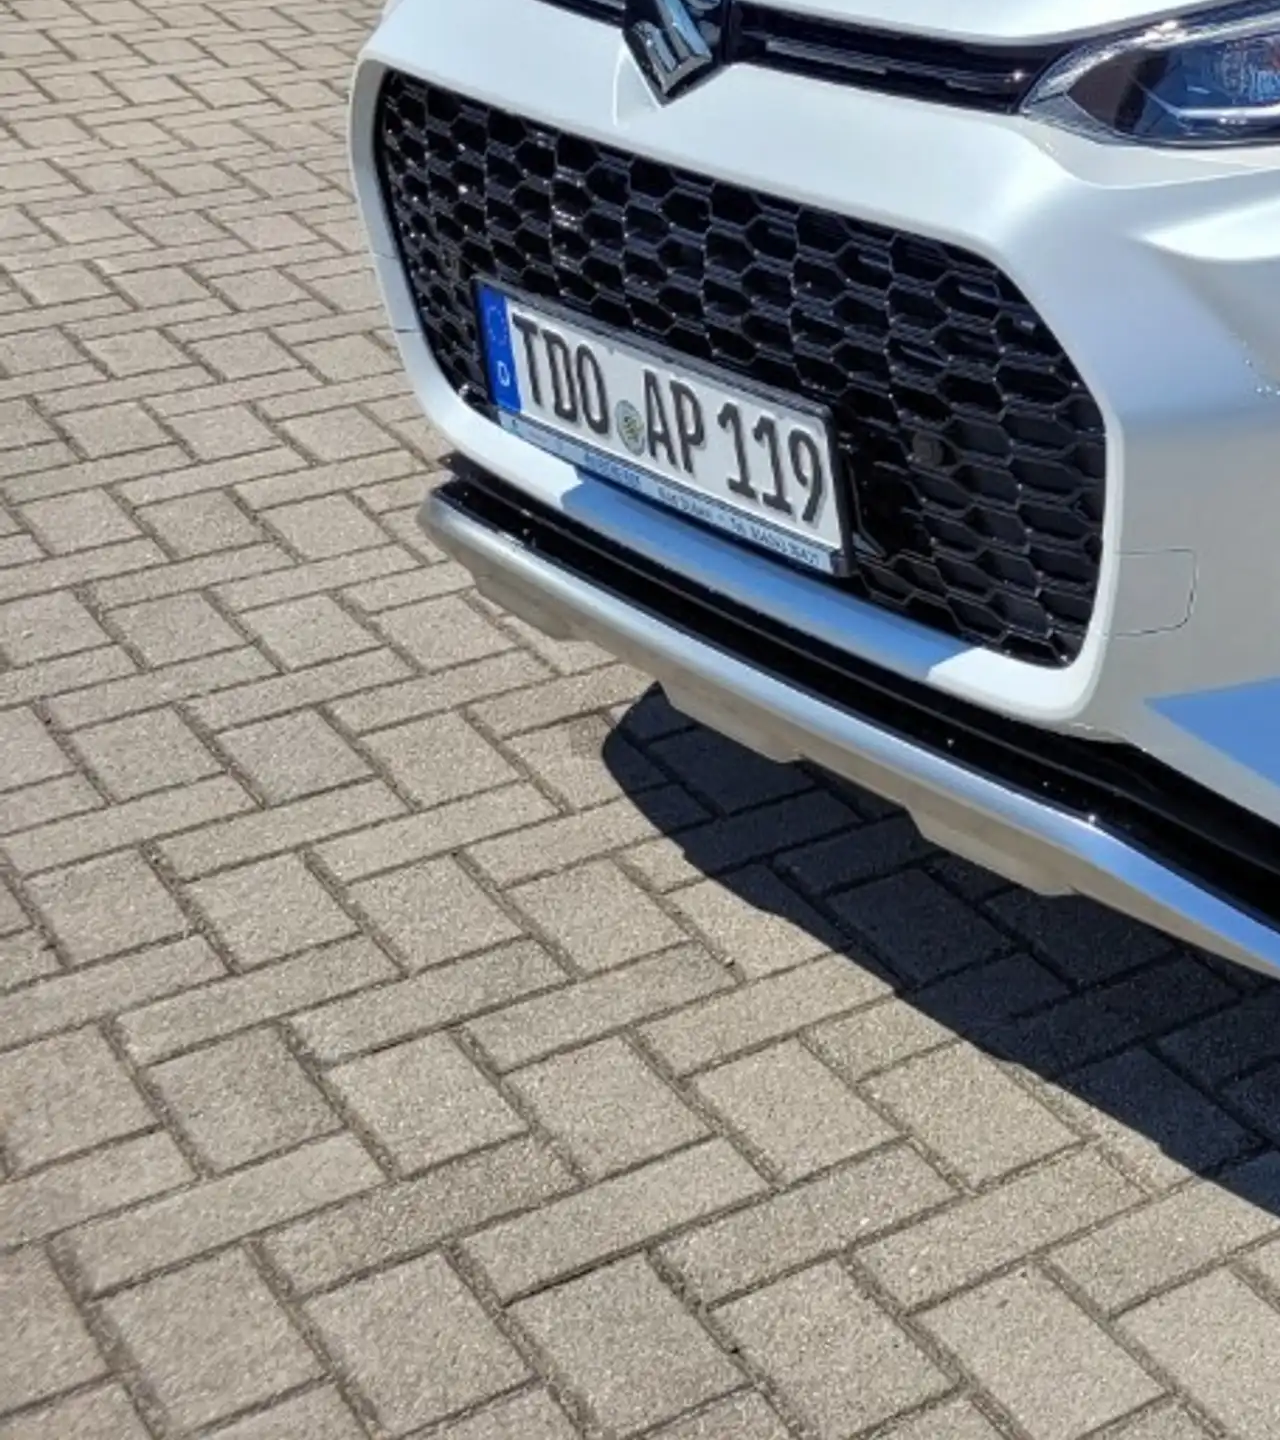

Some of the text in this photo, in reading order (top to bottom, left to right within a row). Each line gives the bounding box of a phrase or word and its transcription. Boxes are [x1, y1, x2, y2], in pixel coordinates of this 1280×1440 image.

[512, 312, 612, 436] TDO
[642, 368, 705, 474] AP
[717, 401, 824, 524] 119
